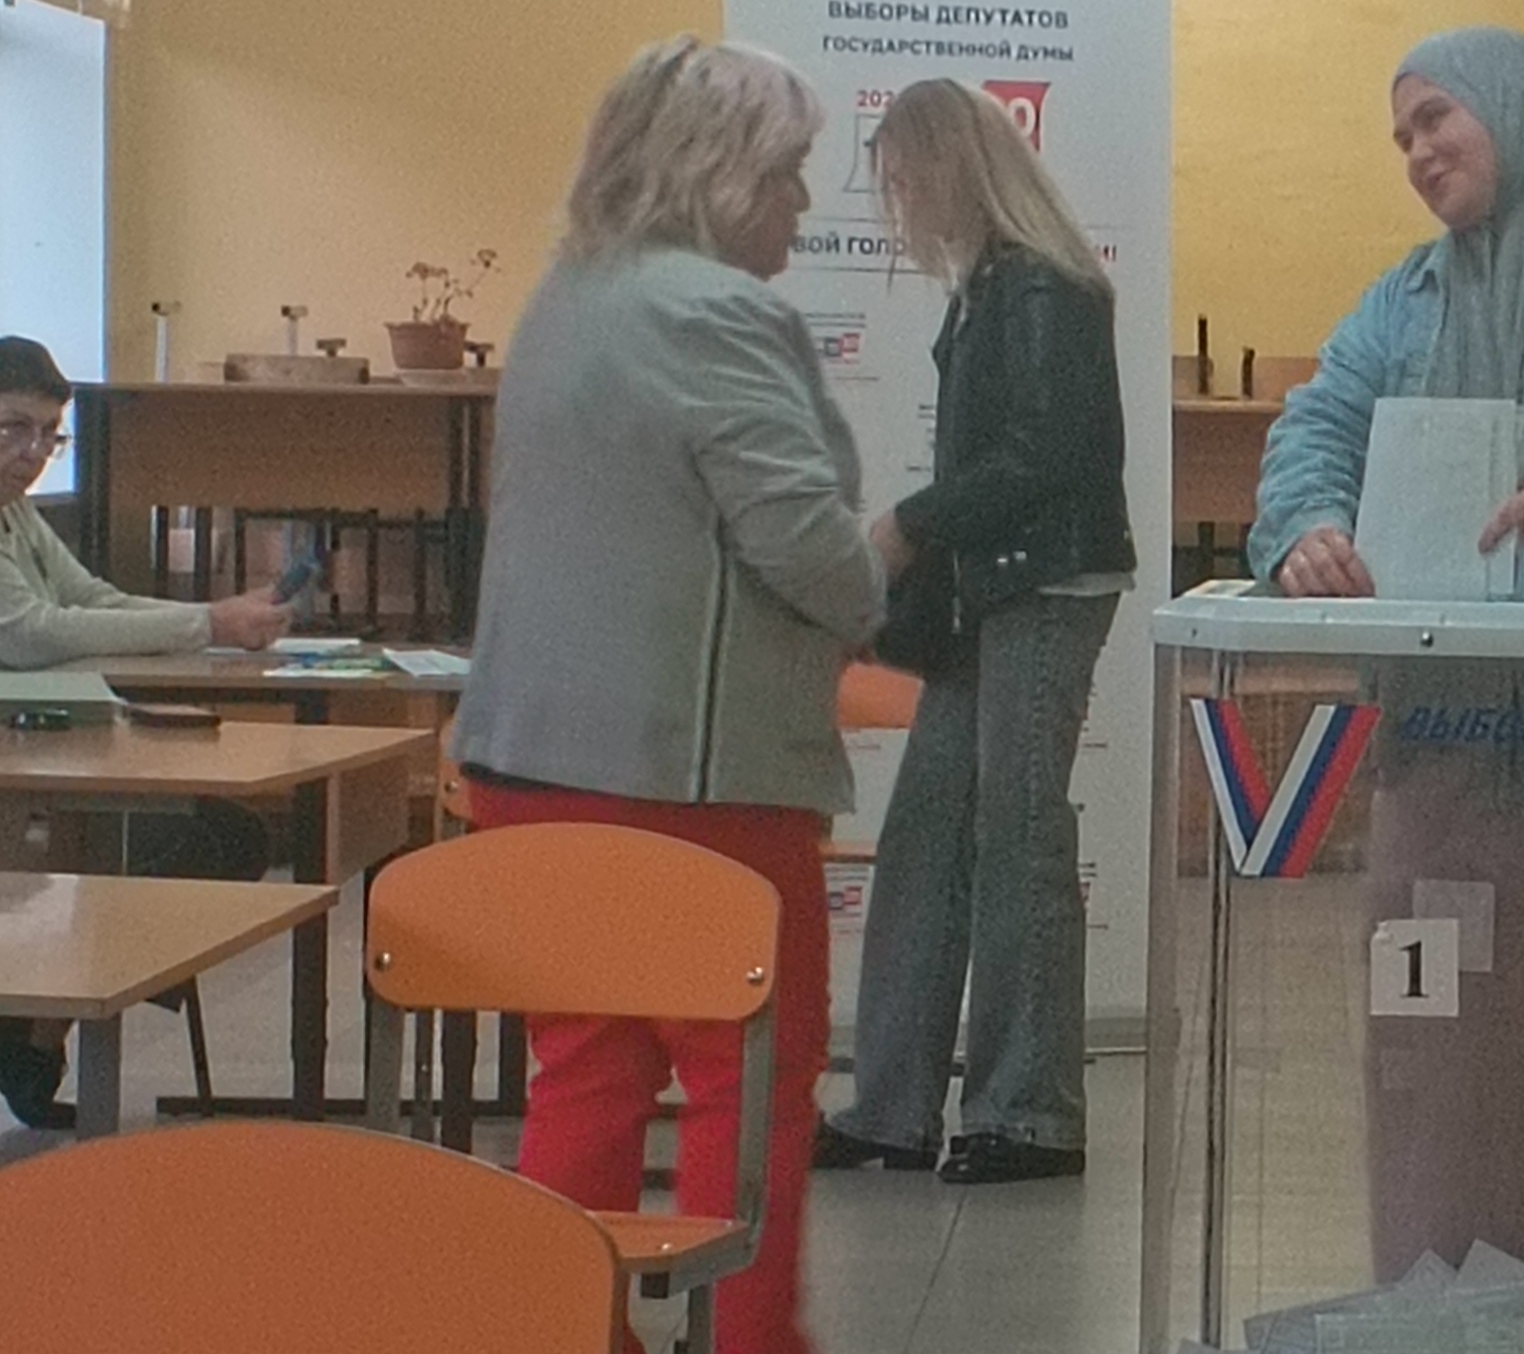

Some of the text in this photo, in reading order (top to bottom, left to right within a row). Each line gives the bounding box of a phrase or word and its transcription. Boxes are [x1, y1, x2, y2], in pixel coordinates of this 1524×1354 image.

[827, 0, 1069, 29] ВЫБОРЫ ДЕПУТАТОВ
[822, 34, 1075, 62] ГОСУДАРСТВЕННОЙ ДУМЫ
[790, 230, 841, 256] вой
[1398, 940, 1431, 999] 1
